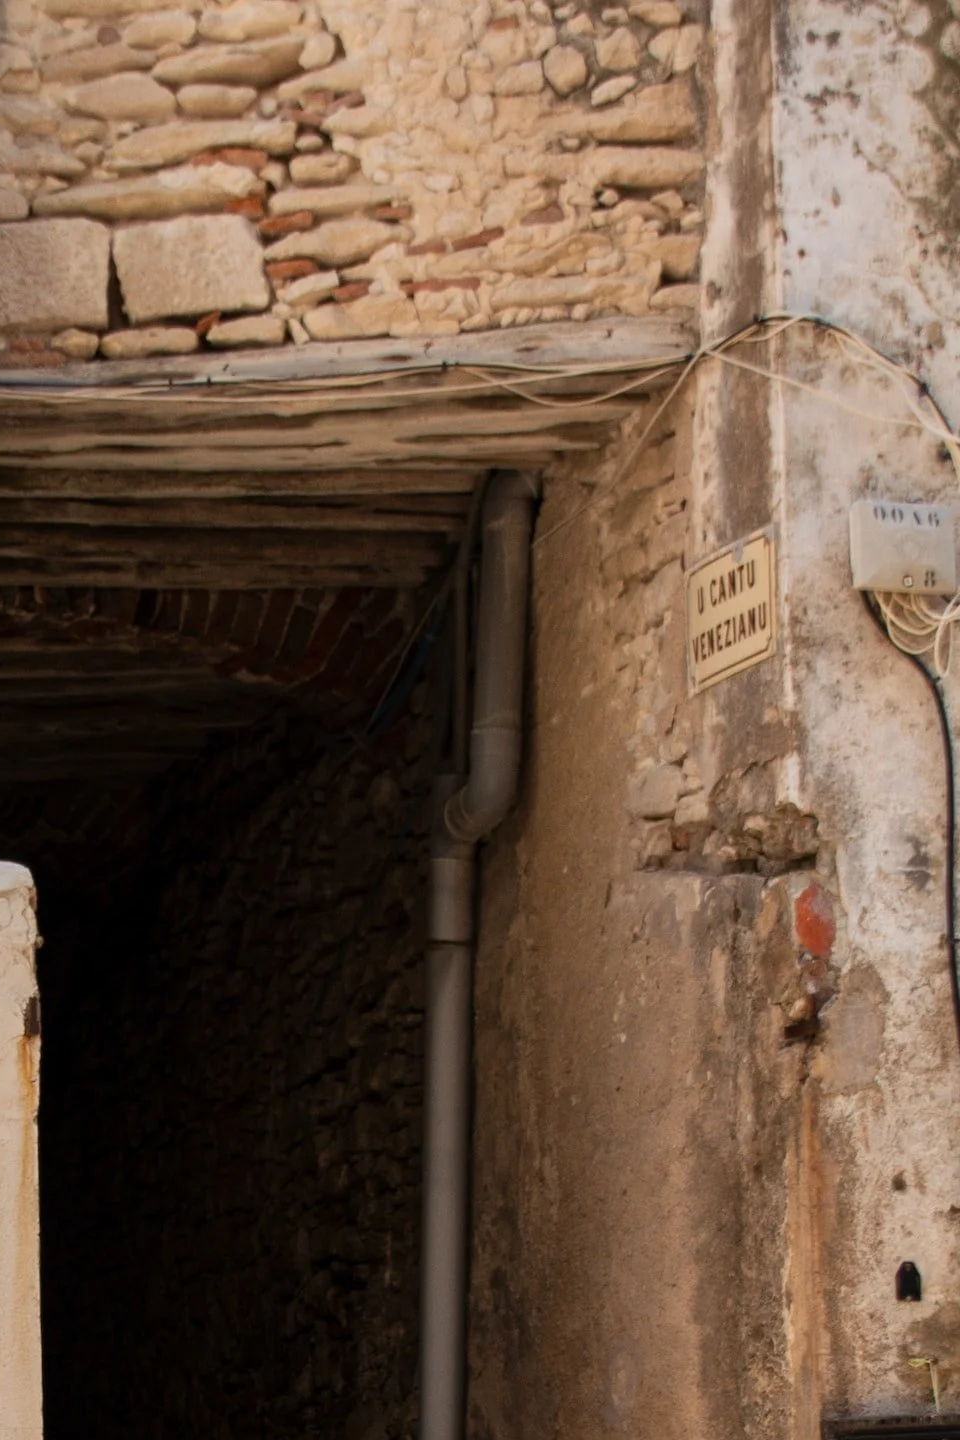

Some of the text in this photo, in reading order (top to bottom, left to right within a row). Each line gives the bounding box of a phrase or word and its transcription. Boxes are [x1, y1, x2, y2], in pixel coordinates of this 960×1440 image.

[697, 560, 755, 615] U CANTU
[692, 602, 766, 664] VENEZIANU
